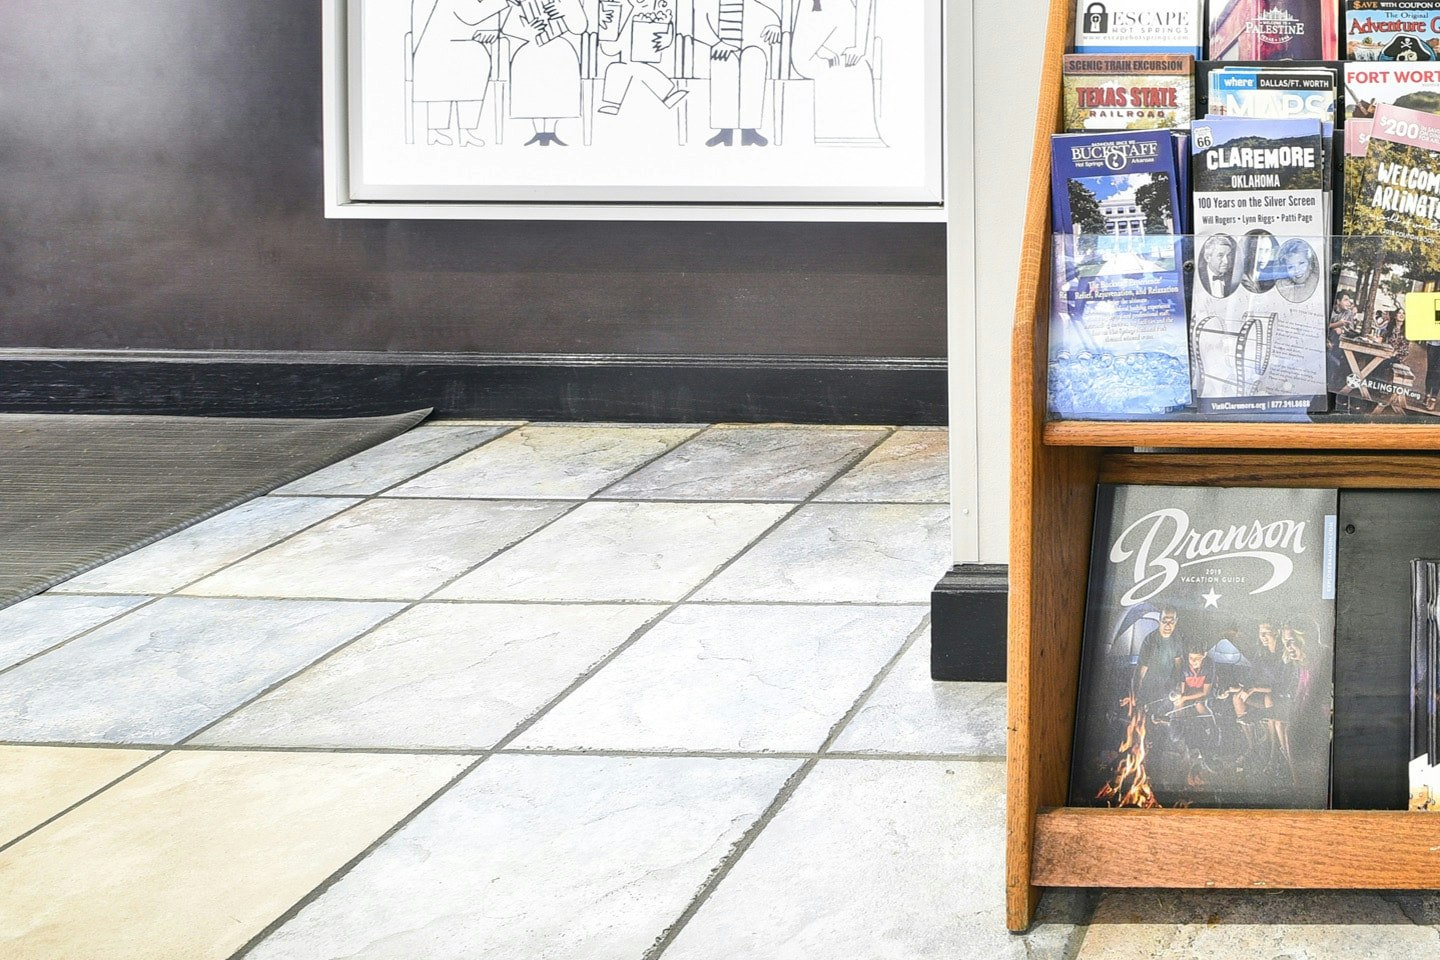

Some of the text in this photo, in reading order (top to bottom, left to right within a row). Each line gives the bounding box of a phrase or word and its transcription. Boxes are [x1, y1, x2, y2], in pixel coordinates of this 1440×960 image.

[1398, 0, 1434, 9] COUPON
[1112, 11, 1189, 26] ESCAPE
[1384, 11, 1429, 20] The Original
[1349, 16, 1427, 35] Adventure
[1069, 60, 1184, 71] SCENIC TRAIN EXCURSION
[1223, 77, 1330, 88] where DALLAS/FT. WORTH
[1347, 71, 1390, 84] FORT
[1076, 87, 1178, 107] TEXAS STATE
[1225, 93, 1326, 116] MAPS
[1089, 110, 1166, 118] RAILROAD
[1196, 135, 1212, 148] 66
[1071, 142, 1158, 160] BUCKSTAFF
[1206, 146, 1316, 171] CLAREMORE
[1231, 174, 1281, 189] OKLAHOMA
[1198, 195, 1316, 209] 100 Years on the Silver Screen
[1202, 213, 1313, 226] Will Rogers Lynn Riggs Patti Page
[1109, 507, 1306, 607] Branson
